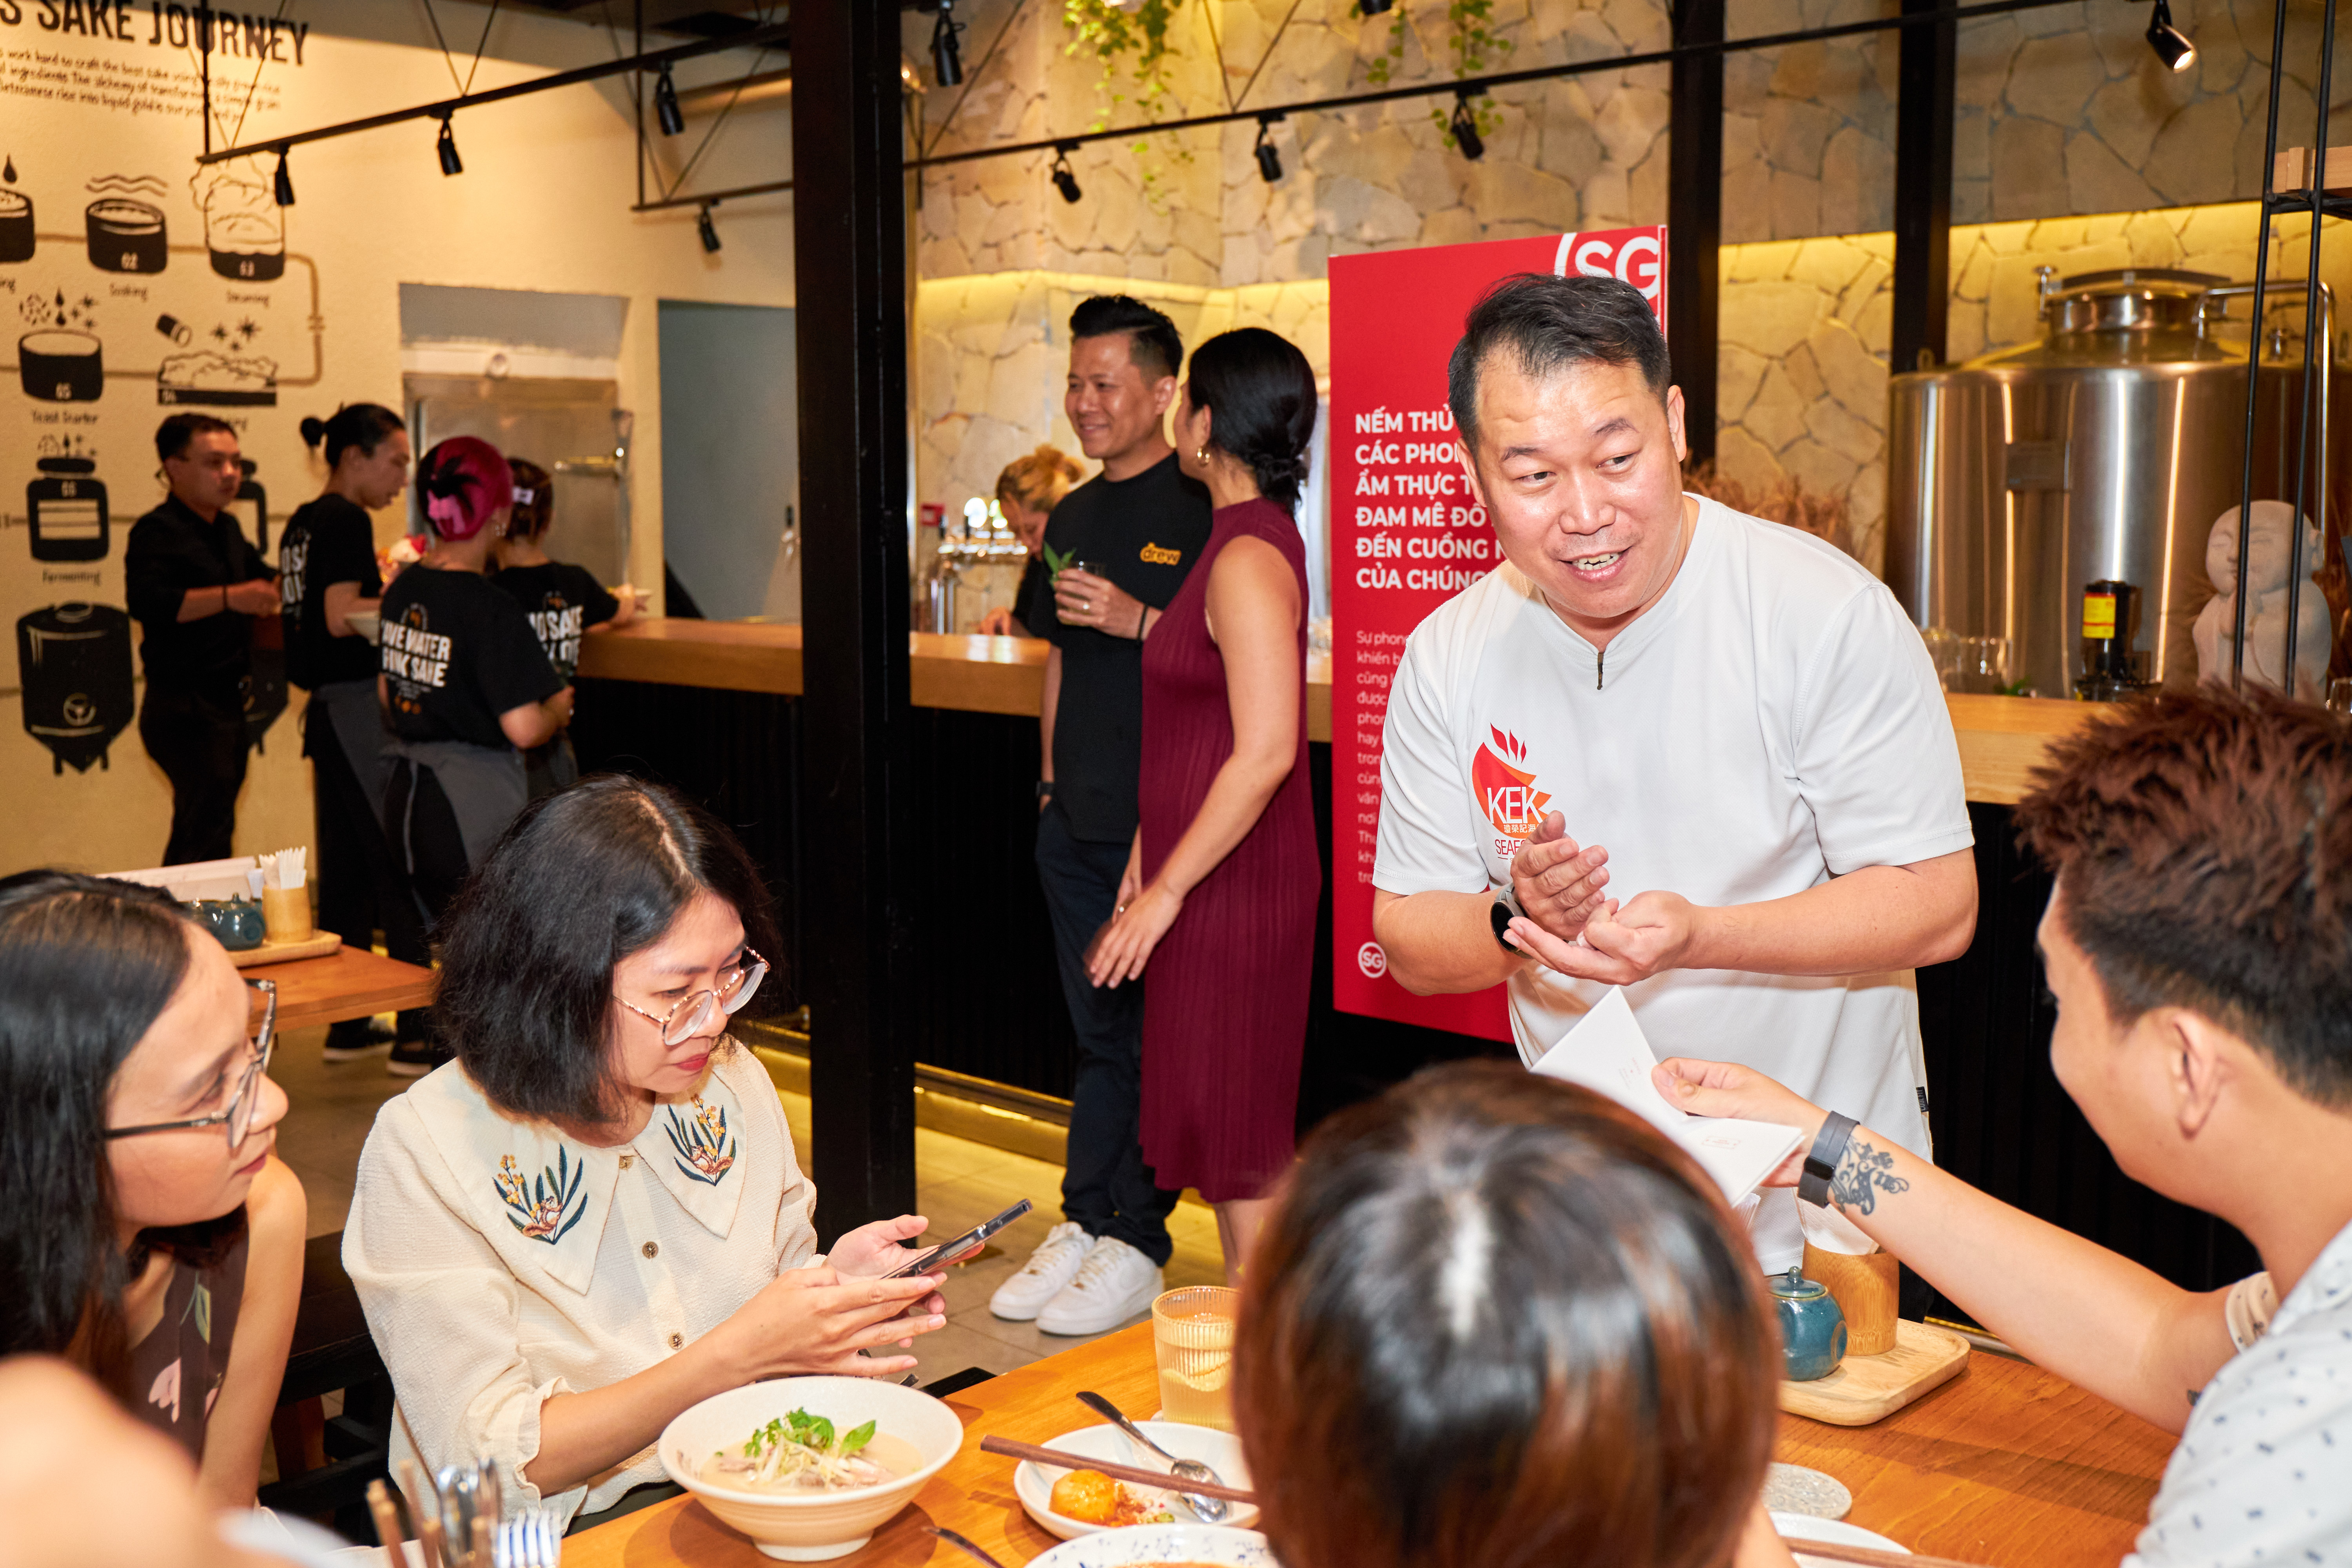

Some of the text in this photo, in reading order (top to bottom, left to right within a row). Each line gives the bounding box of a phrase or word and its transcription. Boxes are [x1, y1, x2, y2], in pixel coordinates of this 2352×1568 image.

[38, 0, 136, 43] SAKE
[1355, 405, 1403, 434] NẾM
[1355, 439, 1400, 465] CÁC
[1355, 468, 1389, 496] ẨM
[1394, 471, 1455, 501] THỰC
[1355, 506, 1406, 527] ĐAM
[1412, 501, 1446, 527] MÊ
[1142, 543, 1181, 564] drew
[1355, 530, 1402, 559] ĐẾN
[1356, 561, 1403, 590] CỦA
[1374, 631, 1409, 647] phon
[1357, 731, 1380, 748] hay
[1487, 786, 1543, 824] KEK
[1503, 823, 1539, 834] 瓊榮記海
[1495, 838, 1526, 855] SEAF
[1363, 951, 1383, 969] SG
